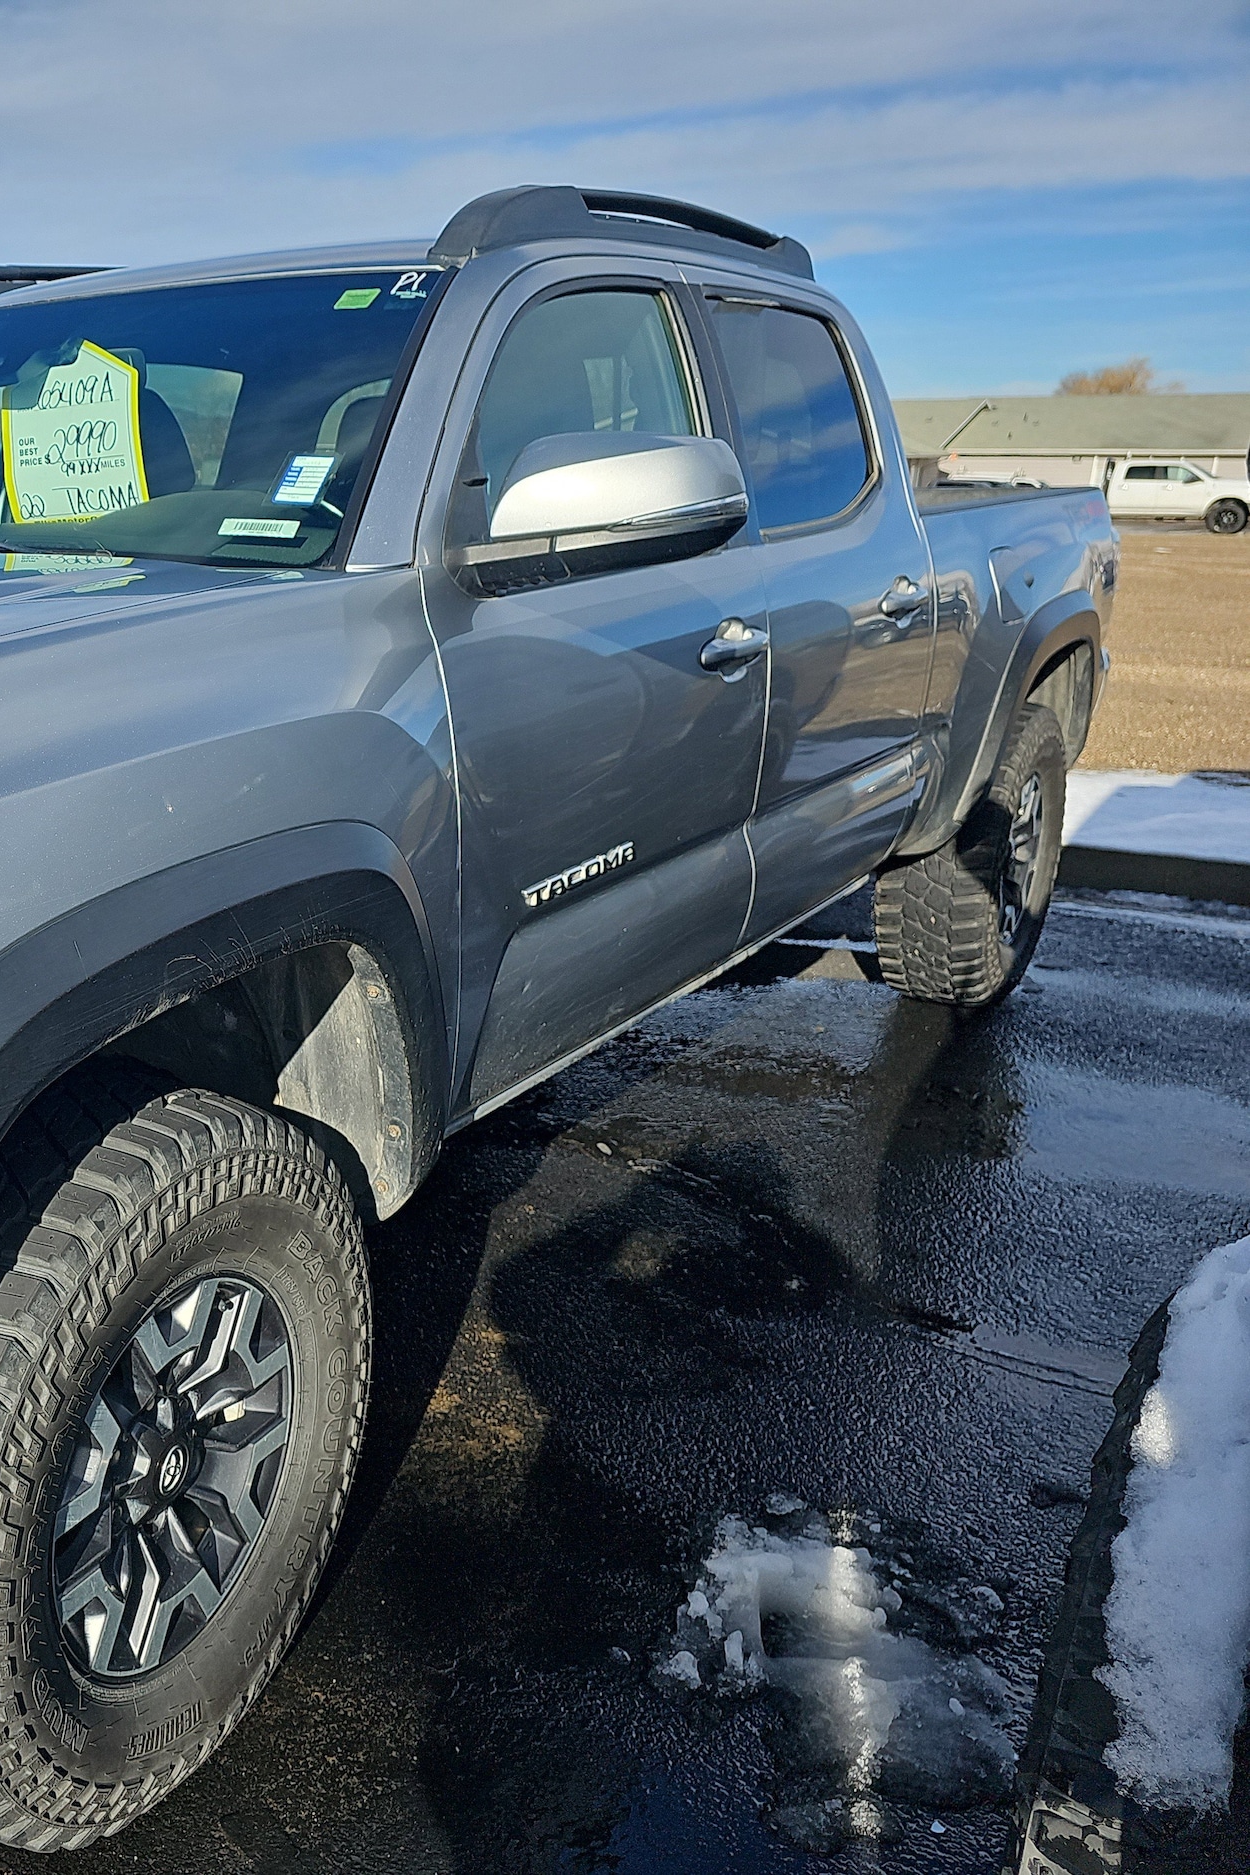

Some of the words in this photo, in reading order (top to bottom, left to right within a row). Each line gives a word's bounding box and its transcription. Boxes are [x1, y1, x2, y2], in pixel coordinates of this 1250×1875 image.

[18, 437, 35, 447] OUR
[19, 447, 38, 457] BEST
[19, 457, 43, 467] PRICE
[100, 458, 126, 469] MILES
[52, 481, 140, 515] TACOMA
[520, 841, 635, 907] TACOMA
[286, 1230, 344, 1340] BACK
[274, 1347, 348, 1613] COUNTRY
[31, 1668, 91, 1756] MUD
